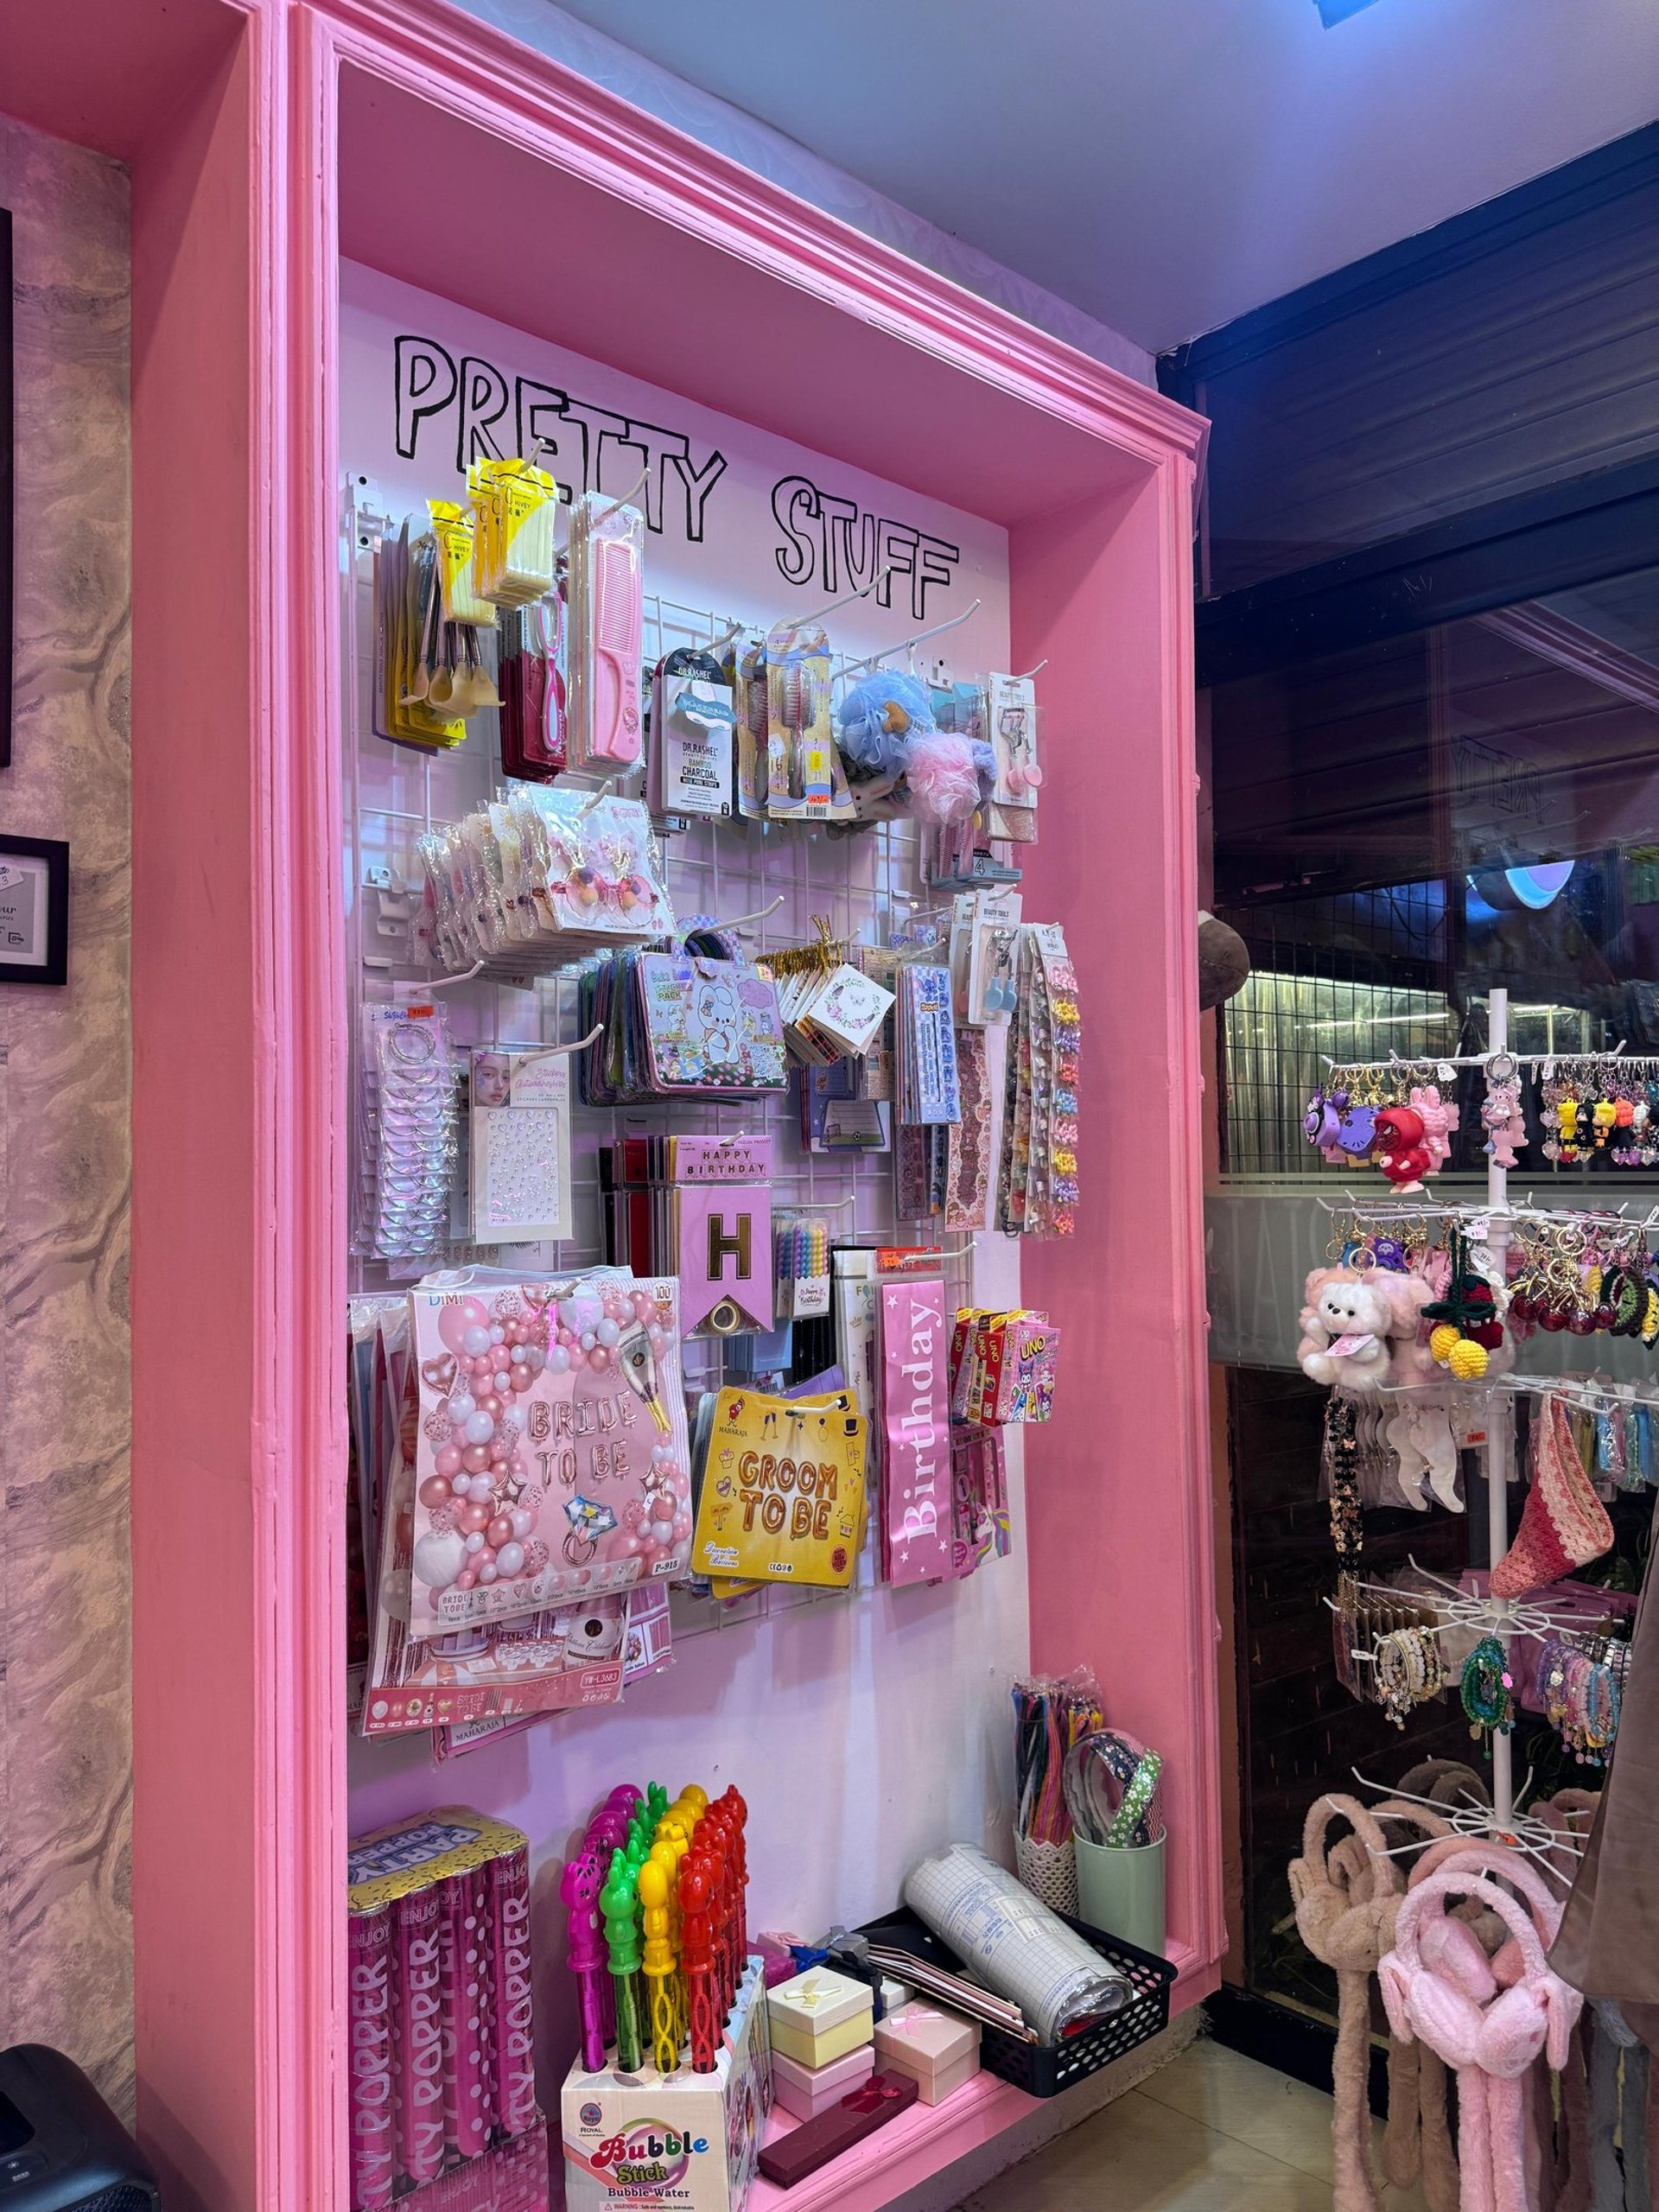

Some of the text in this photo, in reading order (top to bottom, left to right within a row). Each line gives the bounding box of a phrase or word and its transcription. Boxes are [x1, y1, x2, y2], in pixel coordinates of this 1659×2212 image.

[394, 335, 959, 620] PRETTY STUFF
[683, 742, 718, 757] DR.RASHEL
[683, 766, 718, 780] CHARCOAL
[689, 759, 711, 769] BAMBOO
[975, 859, 985, 876] 4
[702, 1150, 750, 1160] HAPPY
[687, 1164, 764, 1174] BIRTHDAY
[707, 1213, 752, 1281] H
[654, 1286, 671, 1300] 100
[989, 1340, 999, 1363] UNO
[1007, 1330, 1015, 1350] UNO
[1020, 1335, 1046, 1361] UNO
[529, 1390, 638, 1444] BRIDE
[900, 1298, 943, 1544] Birthday
[719, 1425, 748, 1438] MAHARAJA
[537, 1440, 631, 1485] TO BE
[738, 1450, 837, 1500] GROOM
[740, 1489, 832, 1541] TO BE
[655, 1560, 677, 1573] P-915
[456, 1719, 500, 1742] MAHARAJA
[353, 1827, 479, 1885] PARTY
[494, 1864, 528, 1885] ENJO
[400, 1904, 438, 1925] ENJO
[502, 1889, 534, 2058] POPPER
[410, 1929, 442, 2107] POPPER
[352, 1955, 391, 2136] POPPER
[589, 2131, 709, 2169] Bubble
[617, 2161, 669, 2185] Stick
[607, 2188, 690, 2198] Bubble Water
